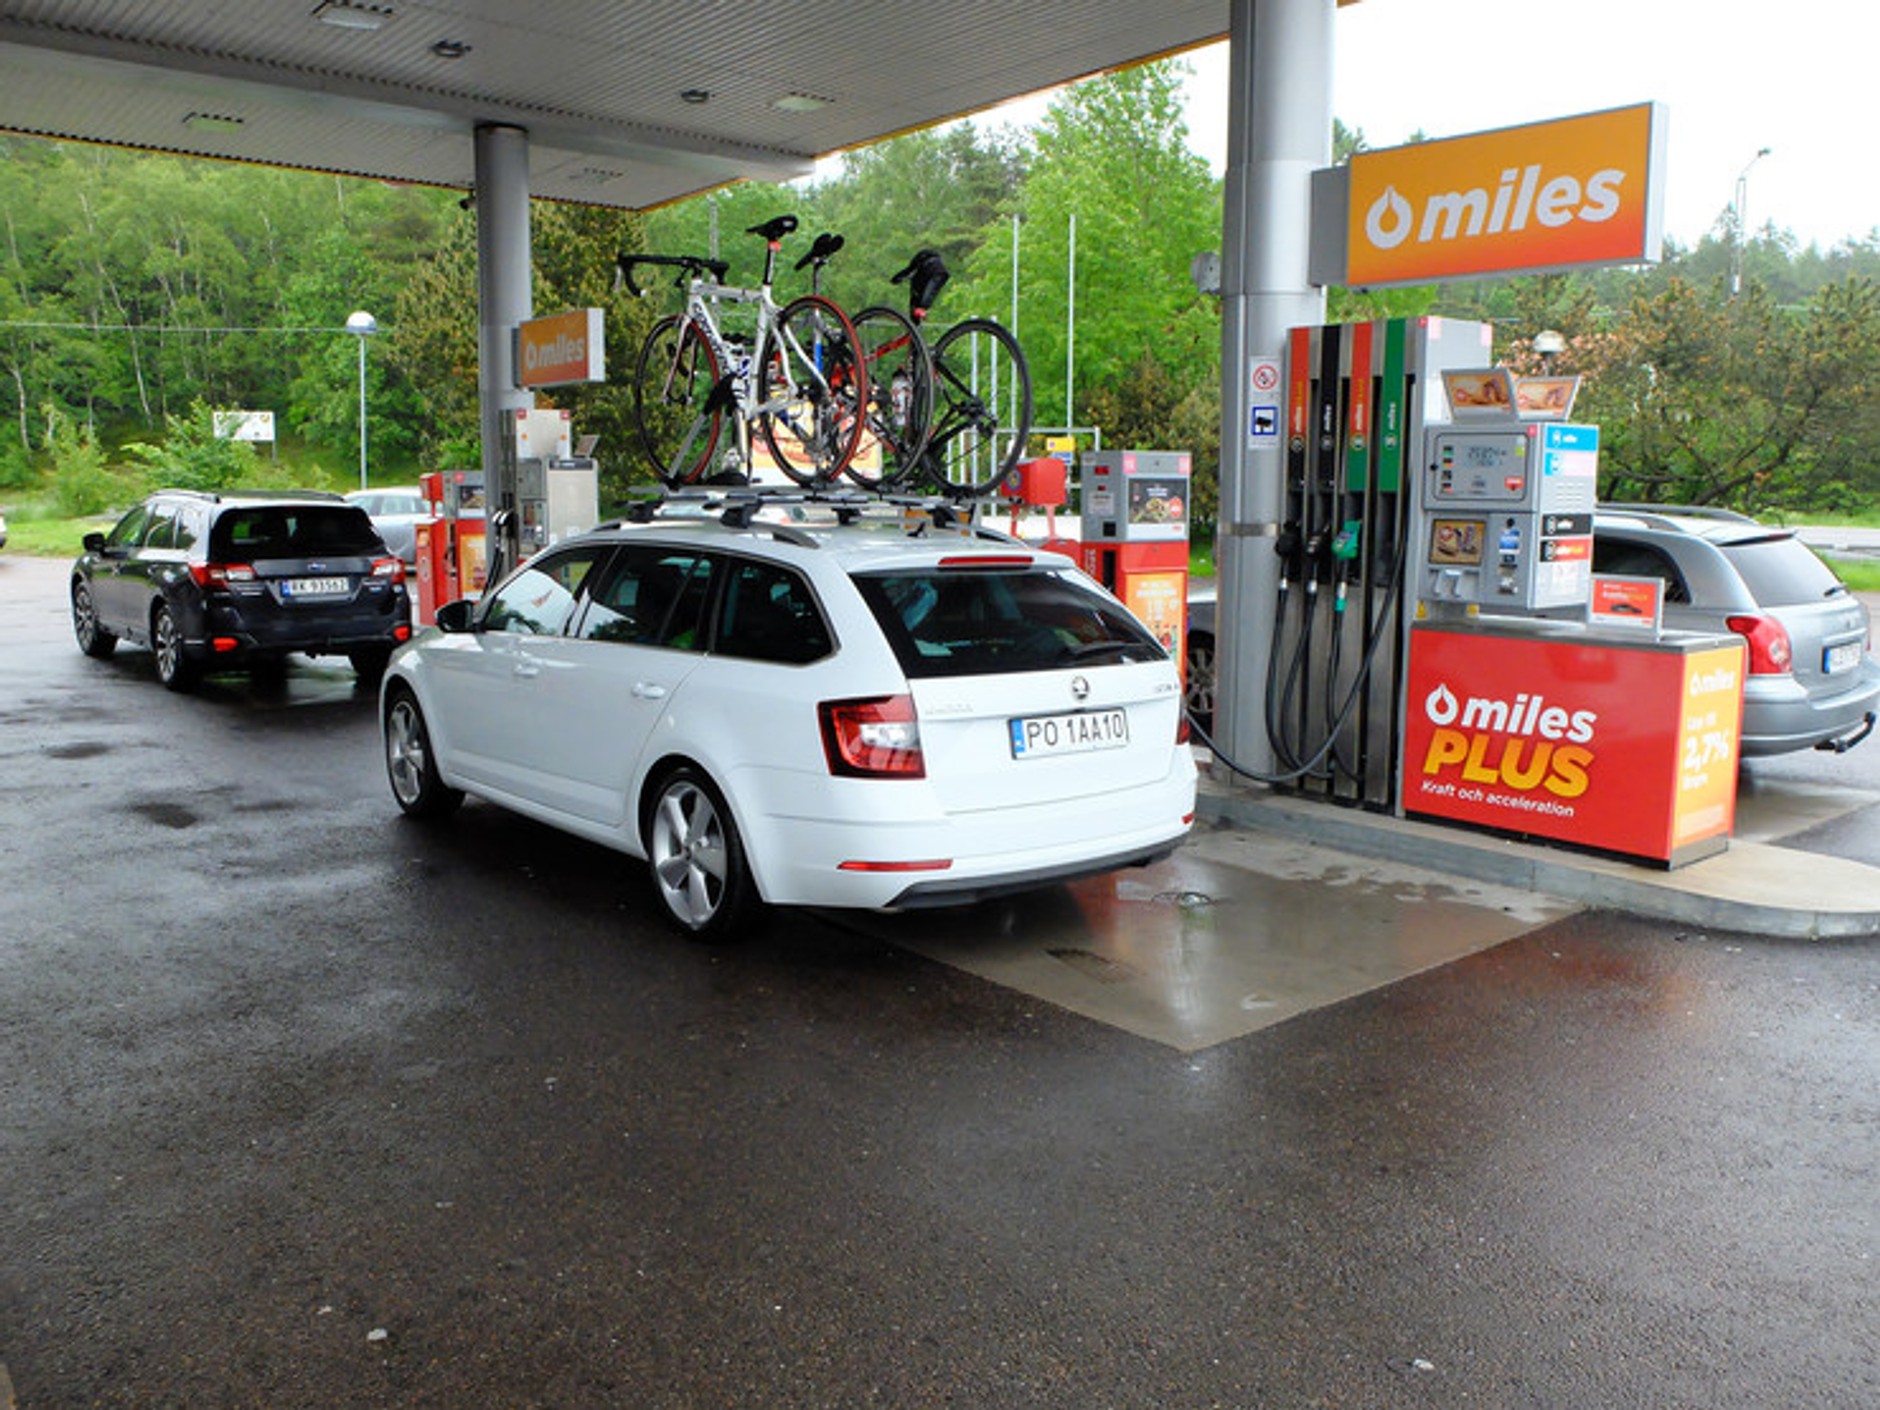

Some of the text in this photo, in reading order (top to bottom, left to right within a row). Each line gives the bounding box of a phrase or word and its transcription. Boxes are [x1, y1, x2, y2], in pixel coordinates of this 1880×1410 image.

[1417, 164, 1627, 243] miles
[538, 334, 585, 368] miles
[1026, 713, 1125, 748] PO 1AA10
[1460, 693, 1597, 743] miles
[1423, 727, 1595, 798] PLUS
[1683, 728, 1732, 772] 2,7%
[1420, 780, 1575, 818] Kraft och acceleration
